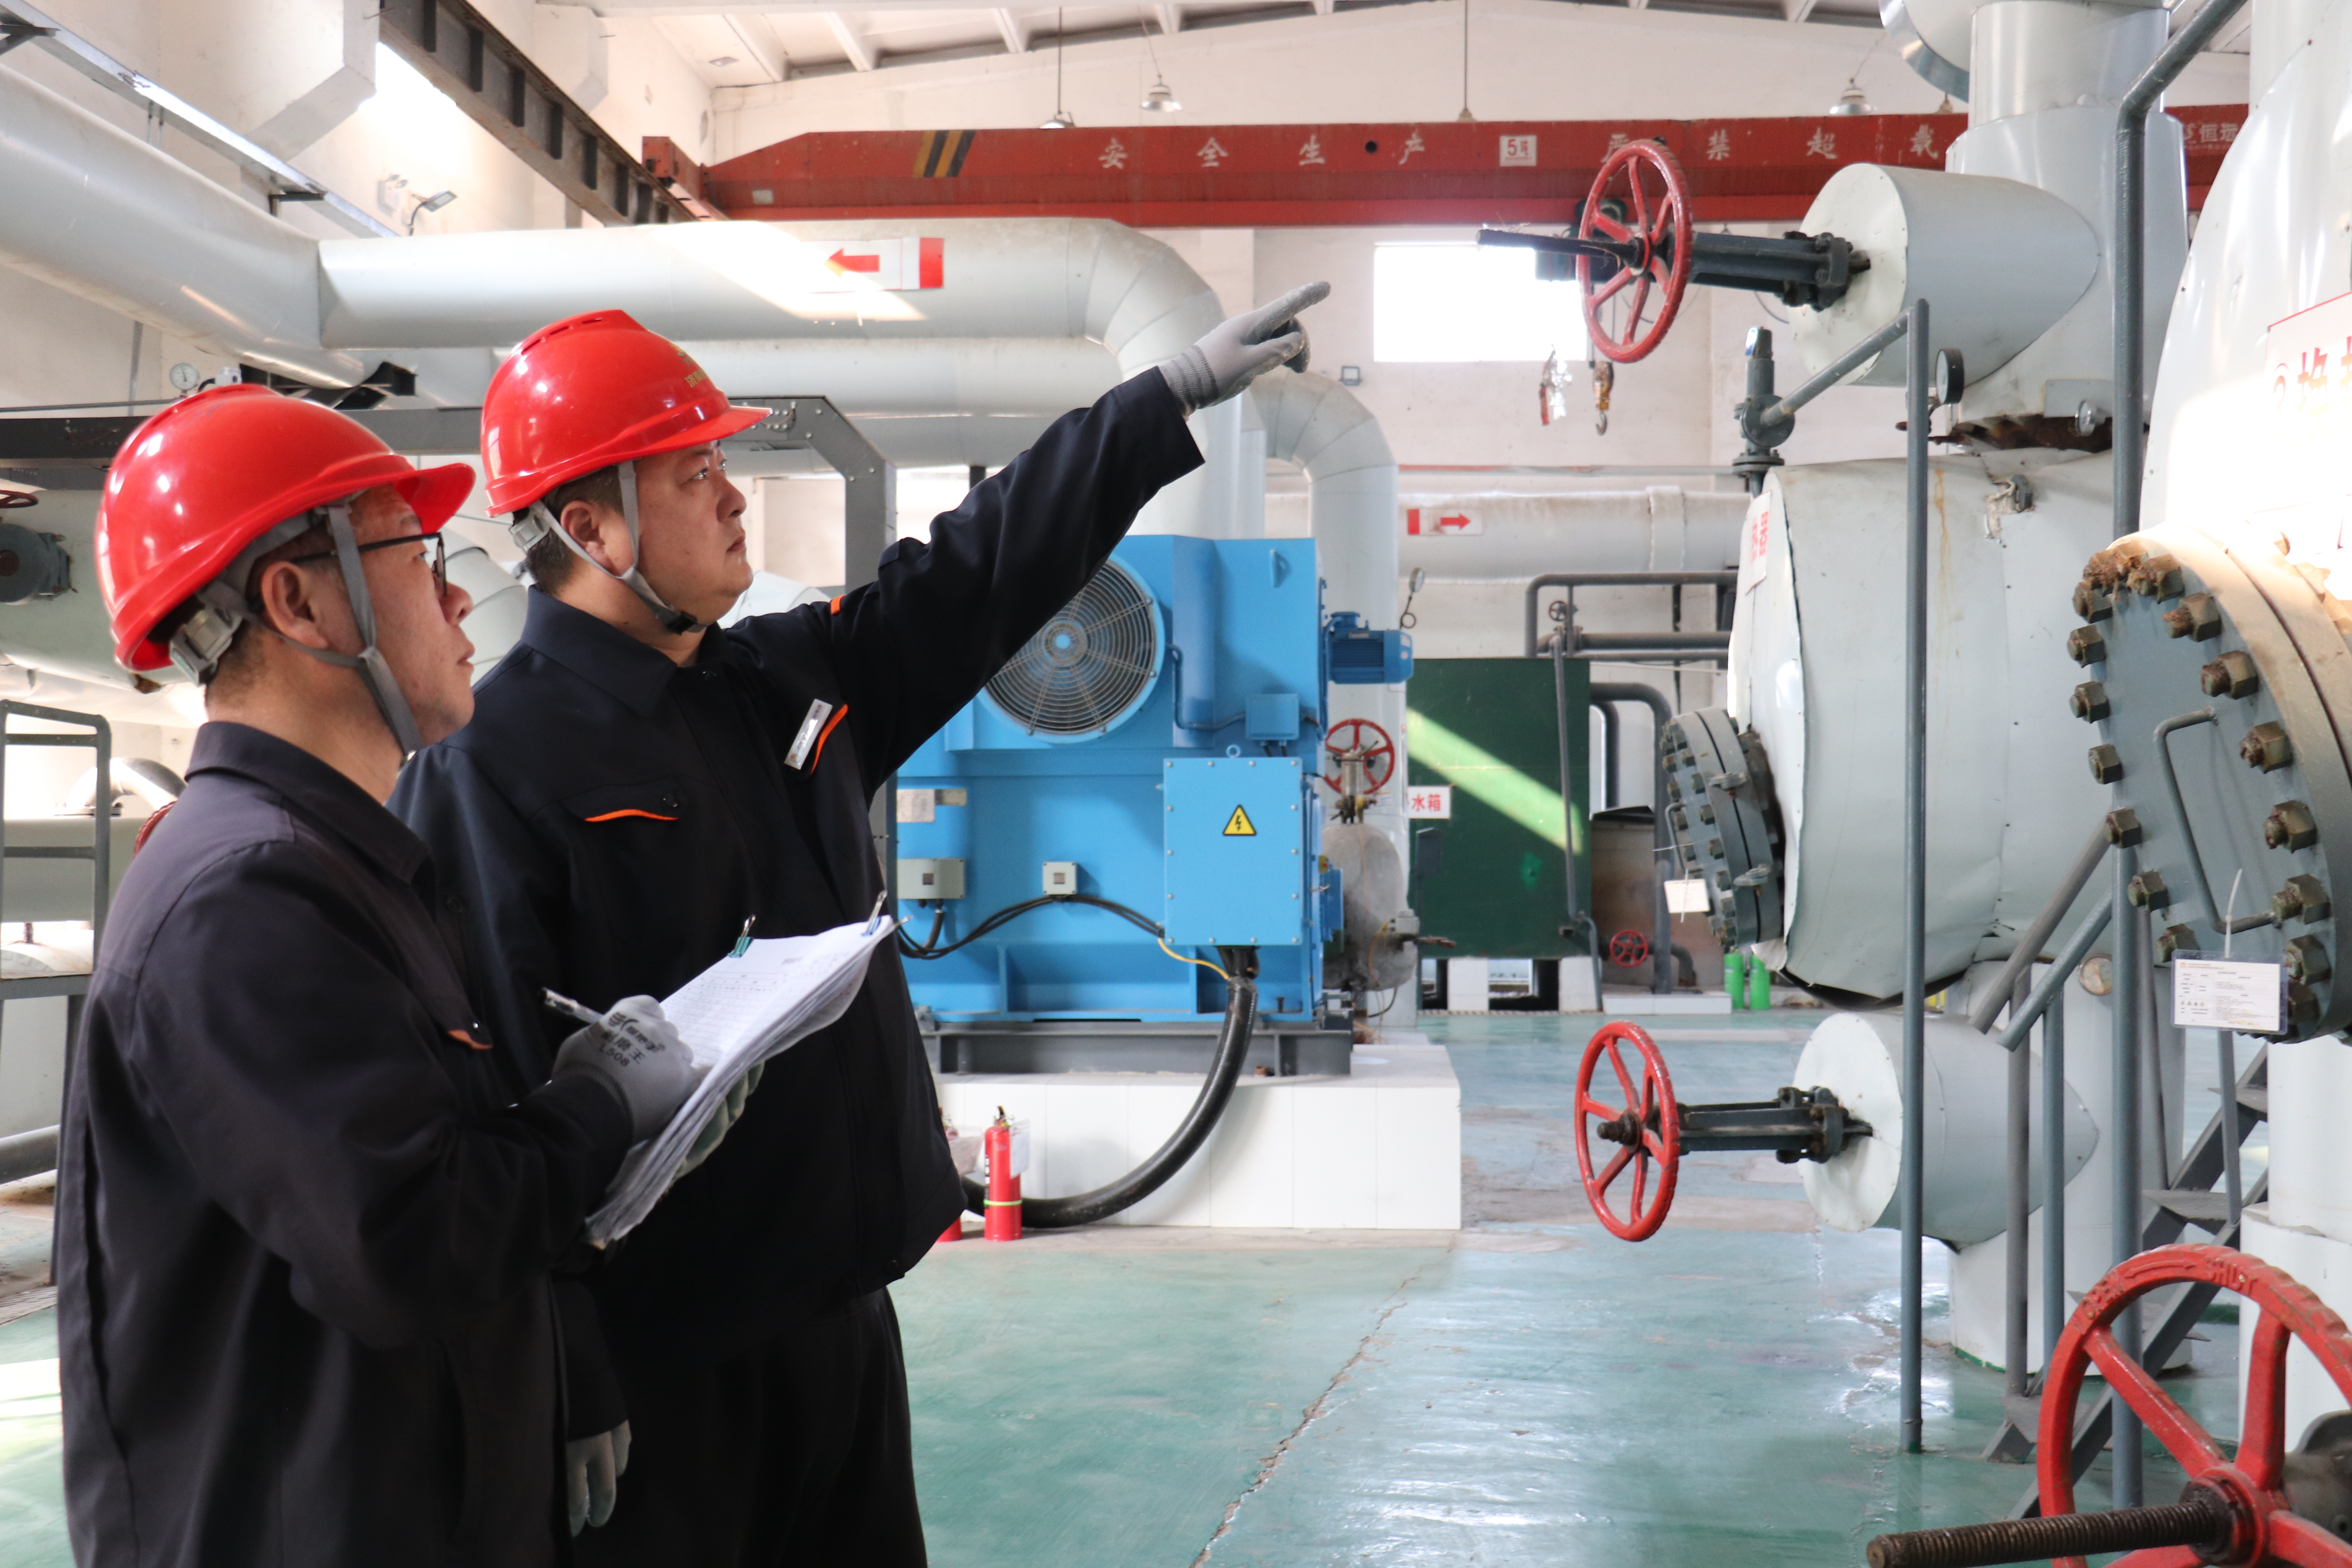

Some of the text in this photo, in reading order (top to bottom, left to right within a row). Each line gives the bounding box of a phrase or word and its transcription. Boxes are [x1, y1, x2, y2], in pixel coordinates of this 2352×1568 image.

[1098, 131, 1425, 169] 安全生产
[1601, 123, 1938, 162] 严禁超载
[1405, 793, 1441, 812] 水箱
[2204, 1257, 2258, 1297] SHUT
